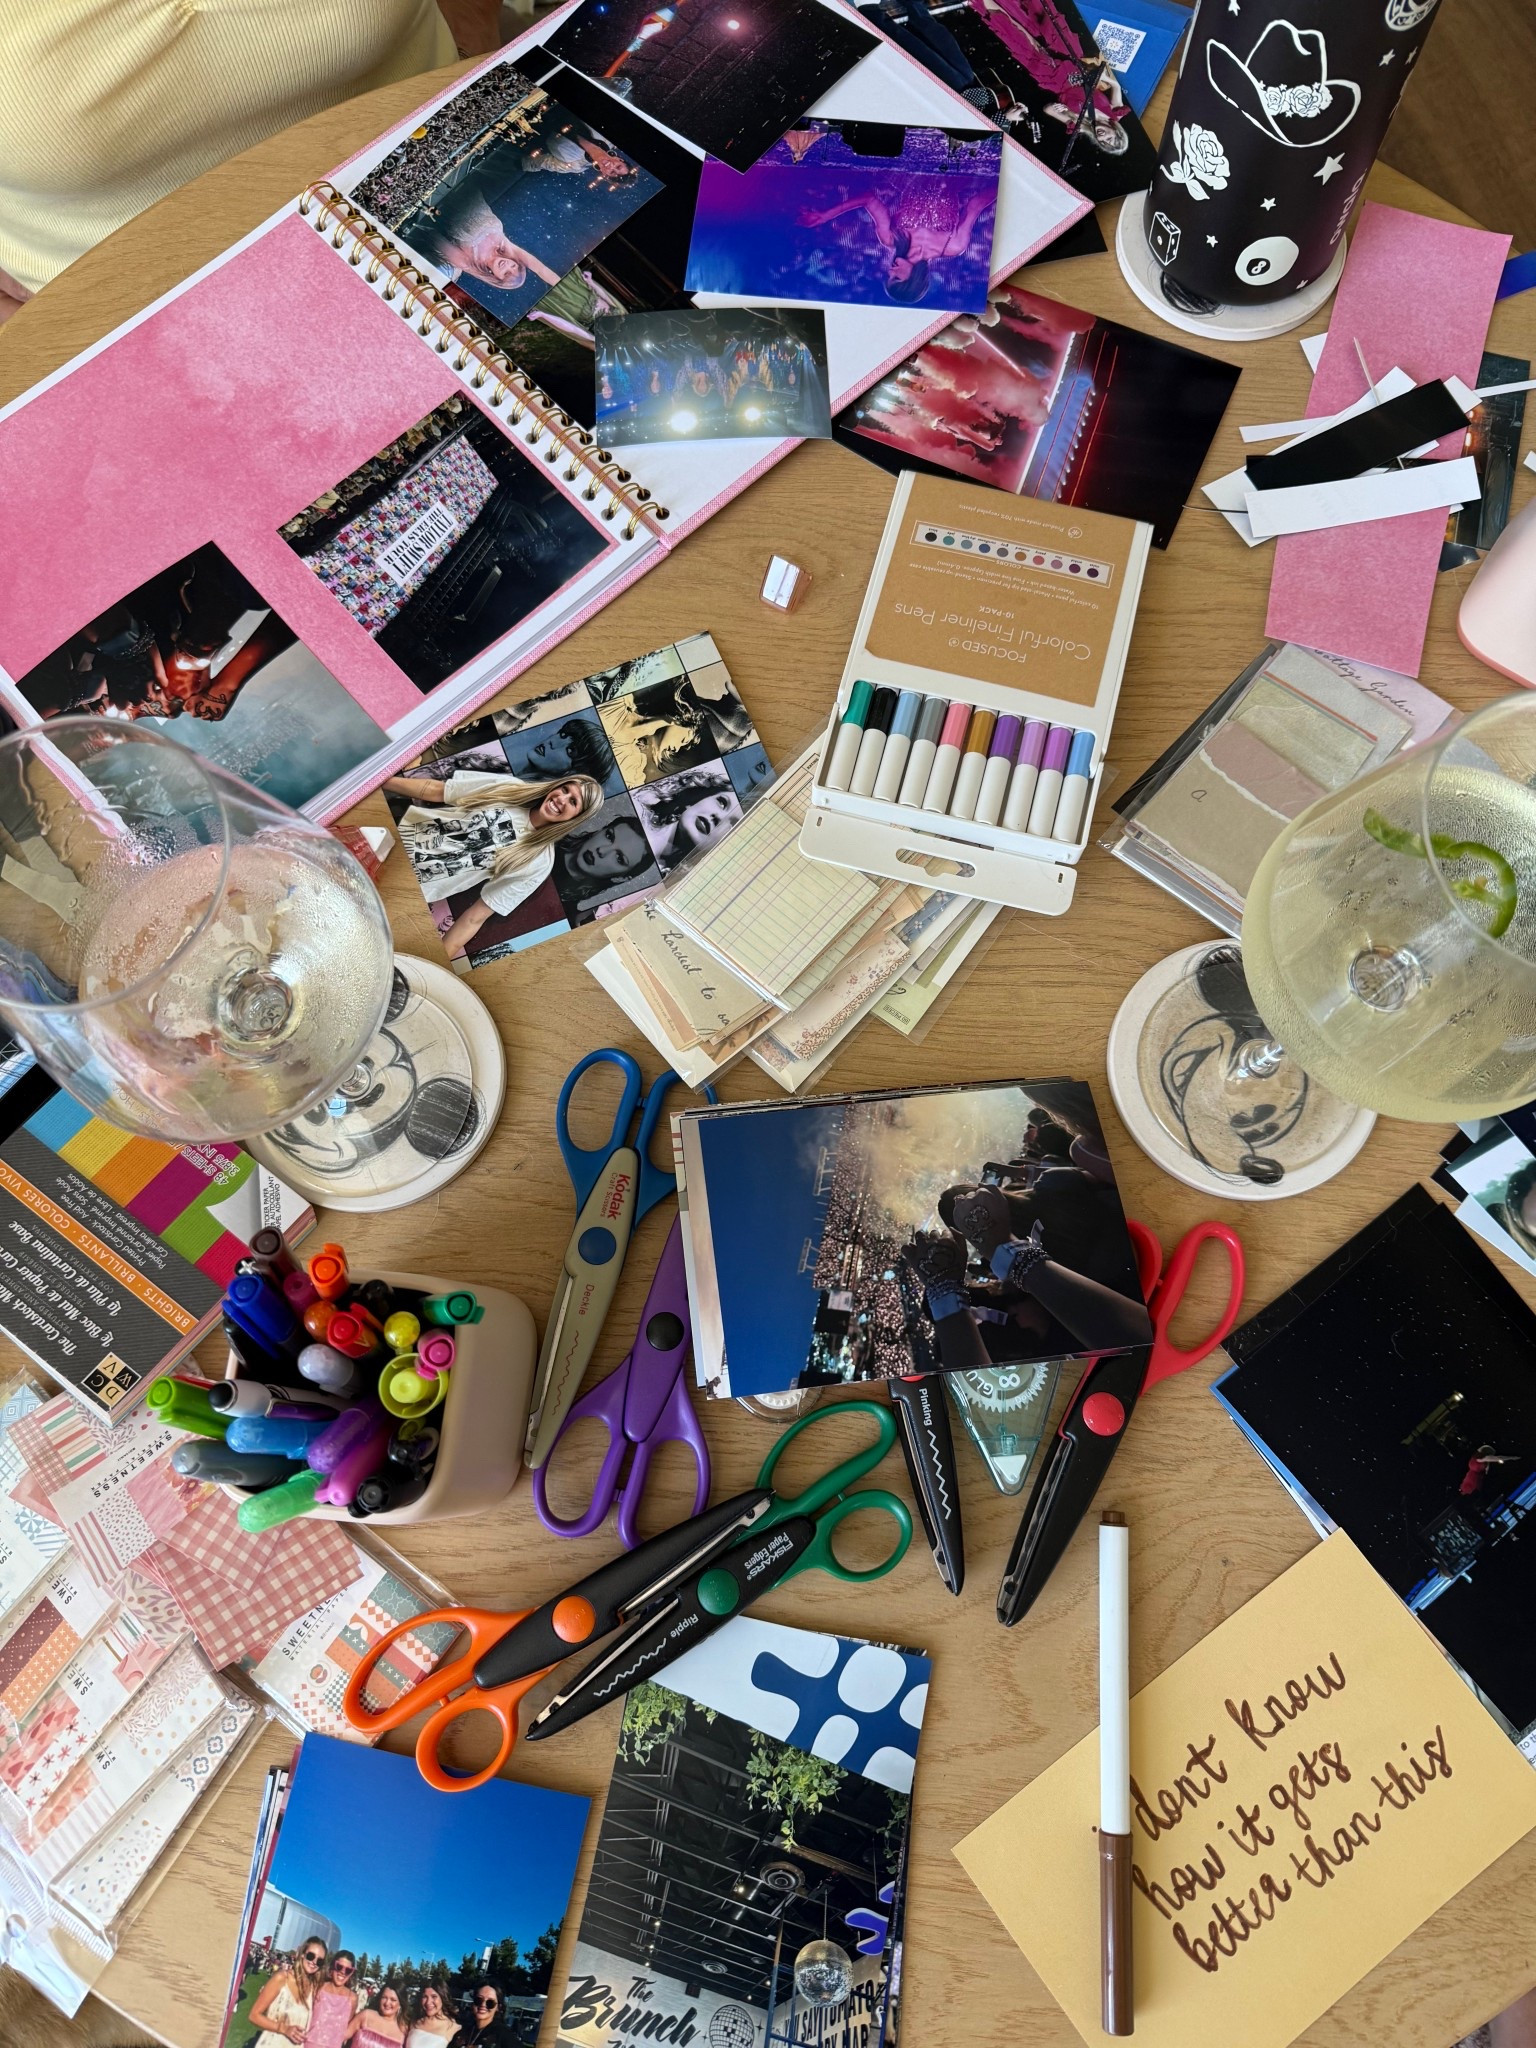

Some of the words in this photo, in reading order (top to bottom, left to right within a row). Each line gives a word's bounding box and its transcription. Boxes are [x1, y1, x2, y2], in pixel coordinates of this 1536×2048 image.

[426, 506, 443, 524] THE
[406, 519, 430, 543] ERAS
[417, 512, 453, 549] TAYLOR
[383, 537, 410, 566] TOUR
[389, 540, 427, 579] SWIFT
[892, 602, 935, 625] Pens
[978, 605, 1014, 618] 10-PACK
[939, 612, 1014, 642] Fineliner
[960, 639, 1026, 663] FOCUSED
[1017, 629, 1092, 661] Colorful
[180, 1142, 218, 1178] SHEETS
[200, 1142, 217, 1159] IN
[0, 1164, 23, 1191] VIVO
[212, 1151, 240, 1178] 3.875
[54, 1175, 74, 1194] Acide
[65, 1172, 88, 1194] Ácidos
[212, 1170, 231, 1188] 48
[59, 1192, 75, 1208] Free
[71, 1189, 88, 1206] Sans
[85, 1188, 97, 1200] de
[94, 1195, 113, 1213] Libre
[607, 1173, 631, 1221] Kodak
[21, 1185, 71, 1232] COLORES
[72, 1203, 89, 1220] Acid
[89, 1203, 118, 1230] Imprimé
[114, 1209, 141, 1235] Impresa
[5, 1217, 34, 1245] Base
[30, 1222, 64, 1254] ADHESIVA
[91, 1218, 124, 1248] Cardstock
[115, 1224, 147, 1253] Cartonné
[138, 1230, 169, 1258] Cartulina
[29, 1236, 77, 1281] Cartulina
[69, 1254, 99, 1282] TEXTURA
[77, 1230, 136, 1285] BRILLANTS
[122, 1243, 146, 1266] Printed
[144, 1247, 167, 1269] Papier
[13, 1259, 51, 1296] Papier
[73, 1273, 90, 1291] de
[97, 1278, 114, 1294] CON
[22, 1290, 39, 1306] AND
[45, 1288, 62, 1305] de
[84, 1283, 110, 1308] Pila
[104, 1297, 124, 1318] La
[142, 1284, 190, 1329] BRIGHTS
[578, 1283, 594, 1315] Deckle
[10, 1295, 60, 1343] Cardstock
[38, 1302, 73, 1334] TEXTURED
[57, 1297, 82, 1322] Mat
[76, 1313, 103, 1339] Bloc
[97, 1329, 116, 1348] Le
[55, 1334, 78, 1358] The
[917, 1387, 933, 1426] Pinking
[92, 1429, 172, 1501] SWEETNESS
[765, 1529, 790, 1553] Paper
[742, 1545, 770, 1571] Edgers
[668, 1610, 699, 1641] Ripple
[1129, 1734, 1228, 1842] dont
[1224, 1652, 1346, 1752] know
[1131, 1843, 1226, 1920] how
[1217, 1804, 1275, 1857] it
[1268, 1742, 1352, 1831] gets
[1172, 1873, 1292, 1973] better
[1289, 1812, 1382, 1888] than
[1370, 1724, 1453, 1810] this
[627, 1975, 654, 2003] The
[561, 1974, 702, 2048] Brunch
[801, 2005, 821, 2042] SAY
